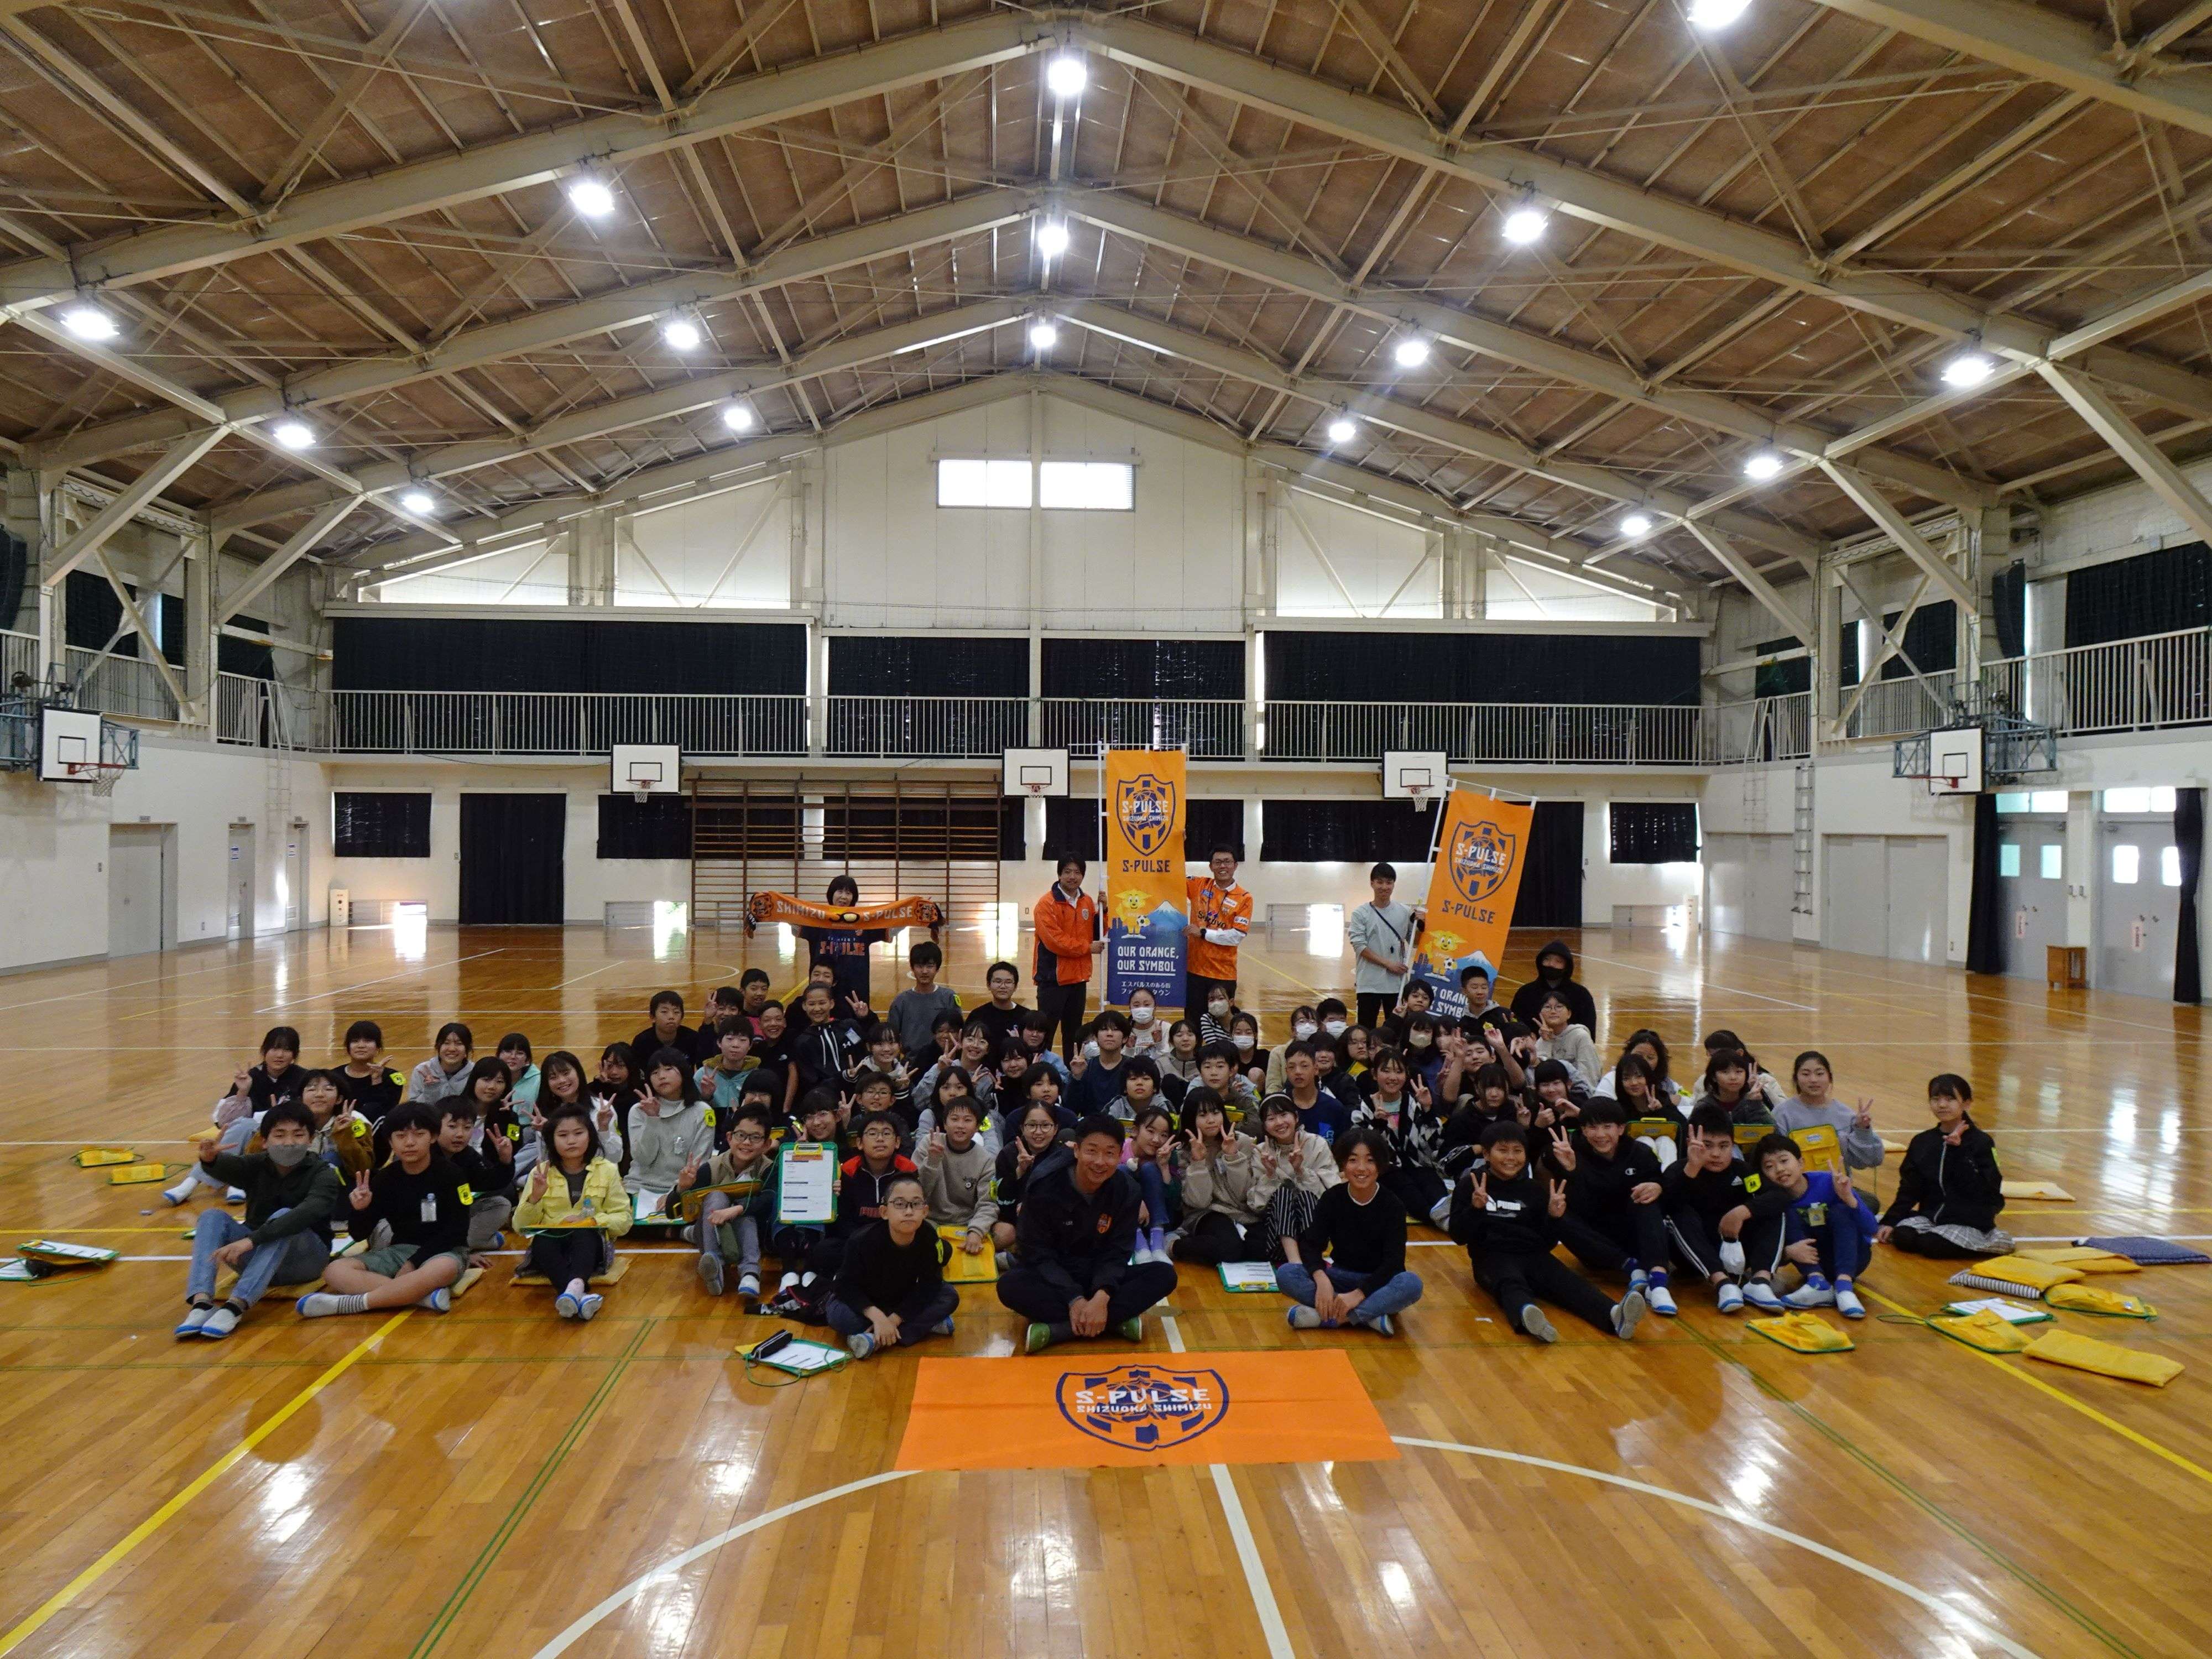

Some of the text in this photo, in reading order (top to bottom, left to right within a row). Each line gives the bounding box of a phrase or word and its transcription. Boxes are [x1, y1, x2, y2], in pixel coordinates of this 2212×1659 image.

[1122, 800, 1168, 813] S-PULSE
[1454, 842, 1507, 866] S-PULSE
[1123, 859, 1170, 872] S-PULSE
[776, 900, 826, 920] SHIMIZU
[863, 905, 913, 922] S-PULSE
[1442, 899, 1495, 924] S-PULSE
[1118, 946, 1179, 959] OUR ORANGE,
[1117, 959, 1176, 972] OUR SYMBOL
[1075, 1388, 1210, 1404] S-PULSE
[1076, 1402, 1212, 1413] SHIZUOKA SHIMIZU
